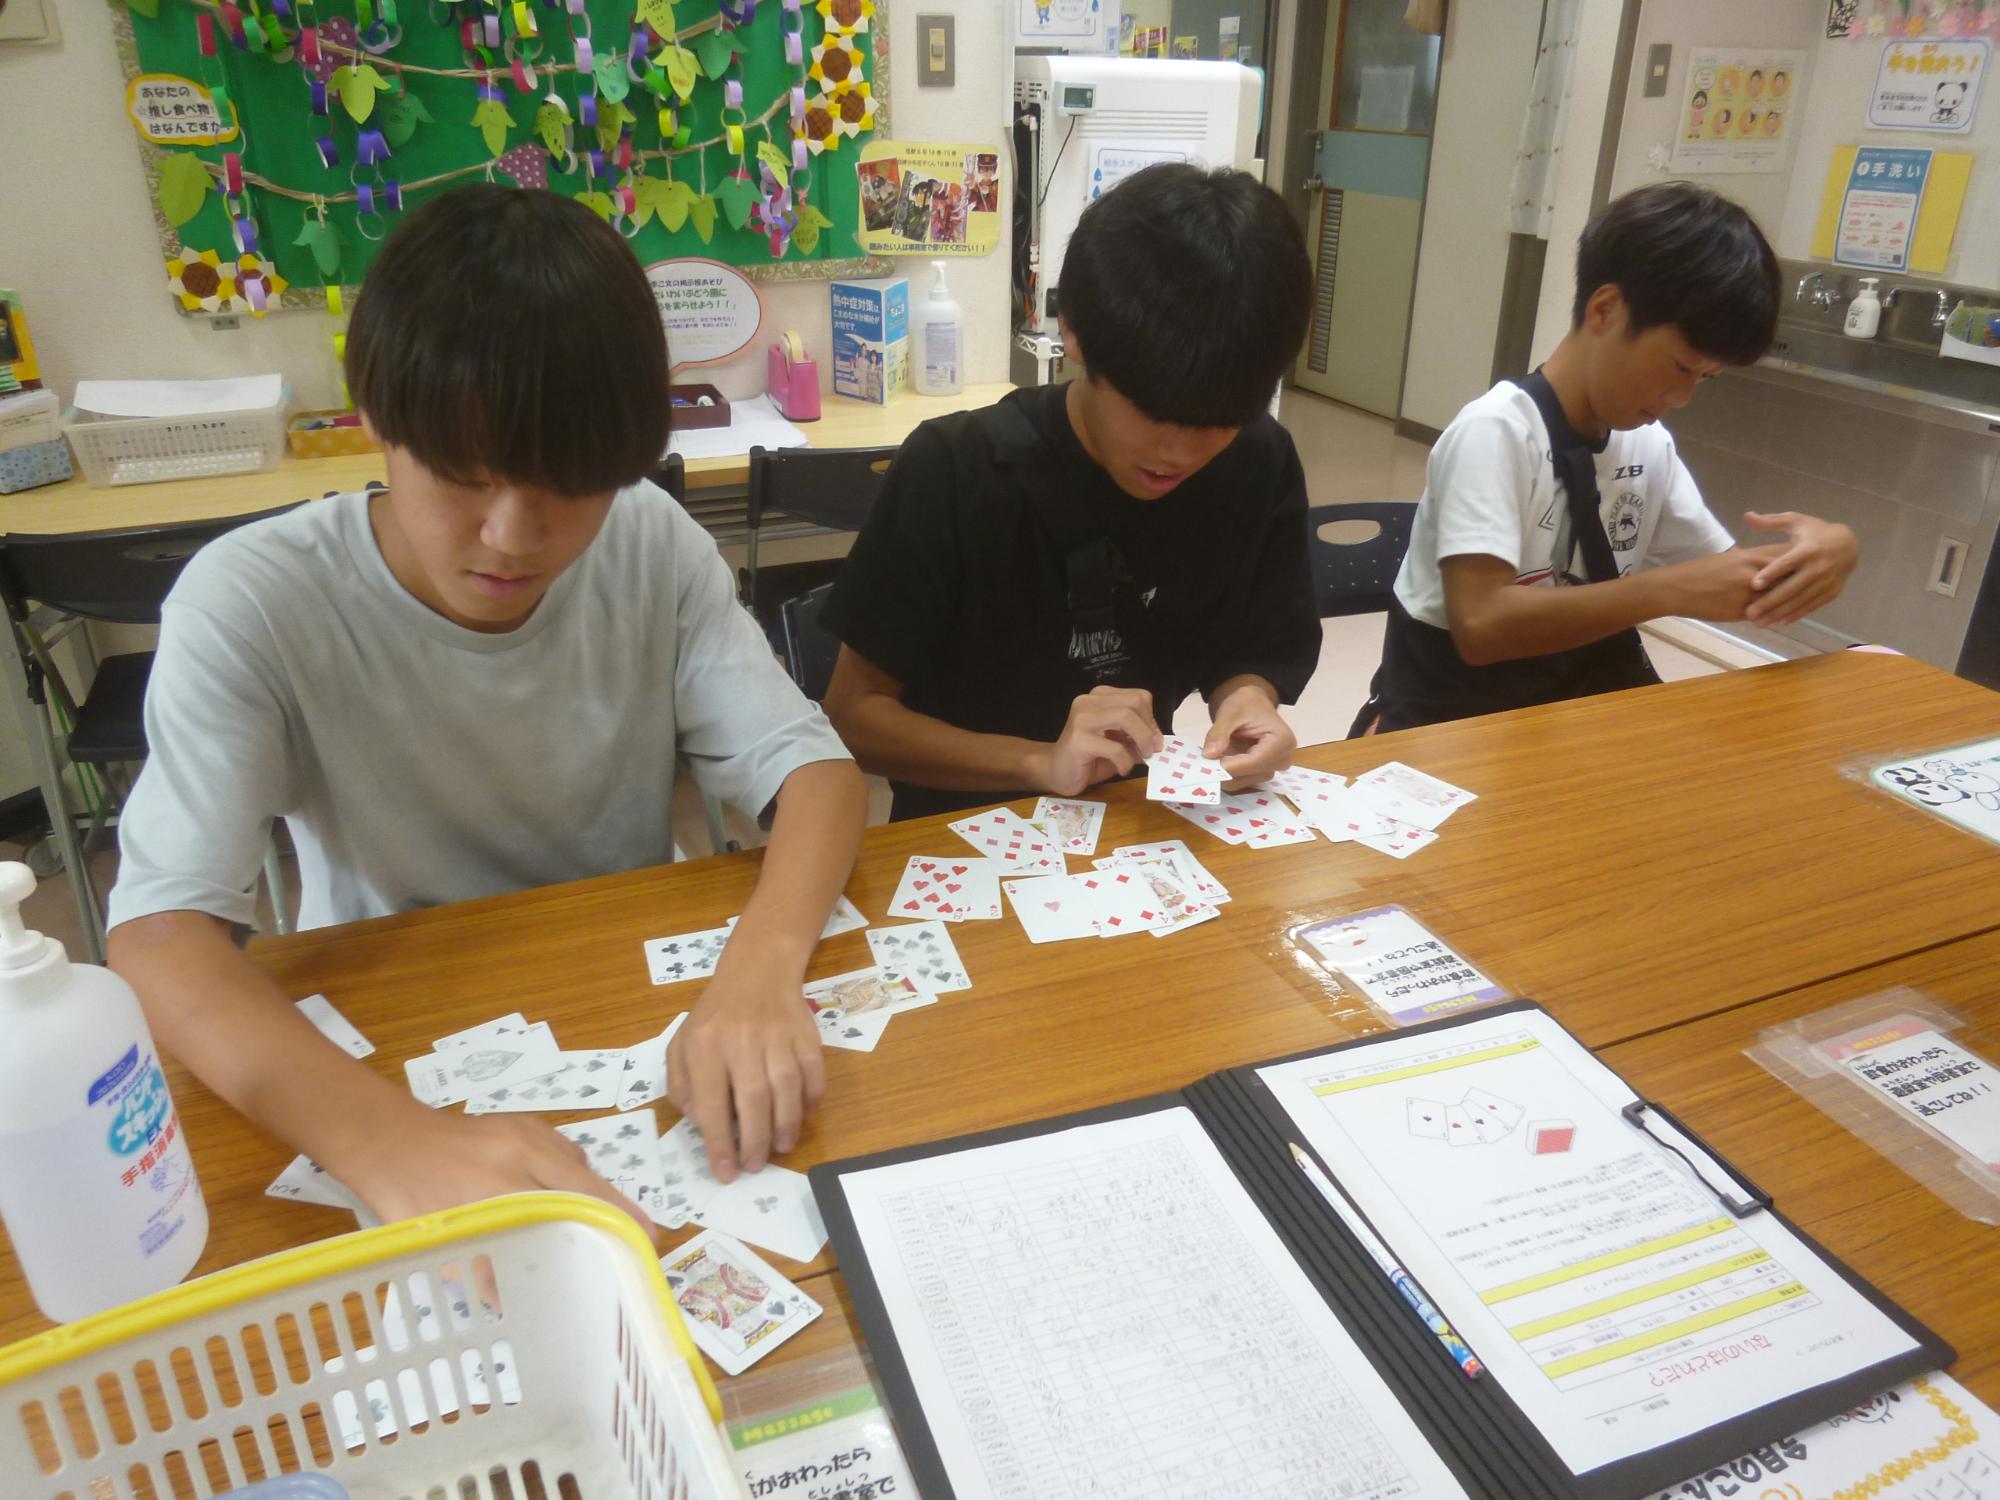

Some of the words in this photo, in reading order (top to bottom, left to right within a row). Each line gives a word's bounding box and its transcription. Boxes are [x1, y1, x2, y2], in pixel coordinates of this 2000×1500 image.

[141, 86, 191, 98] あなたの
[1872, 162, 1921, 178] 手洗い
[1862, 1046, 1948, 1080] 飲食がおわったら
[743, 1406, 834, 1442] Message
[749, 1447, 871, 1498] がおわったら
[1651, 1436, 1807, 1500] 今月のこん
